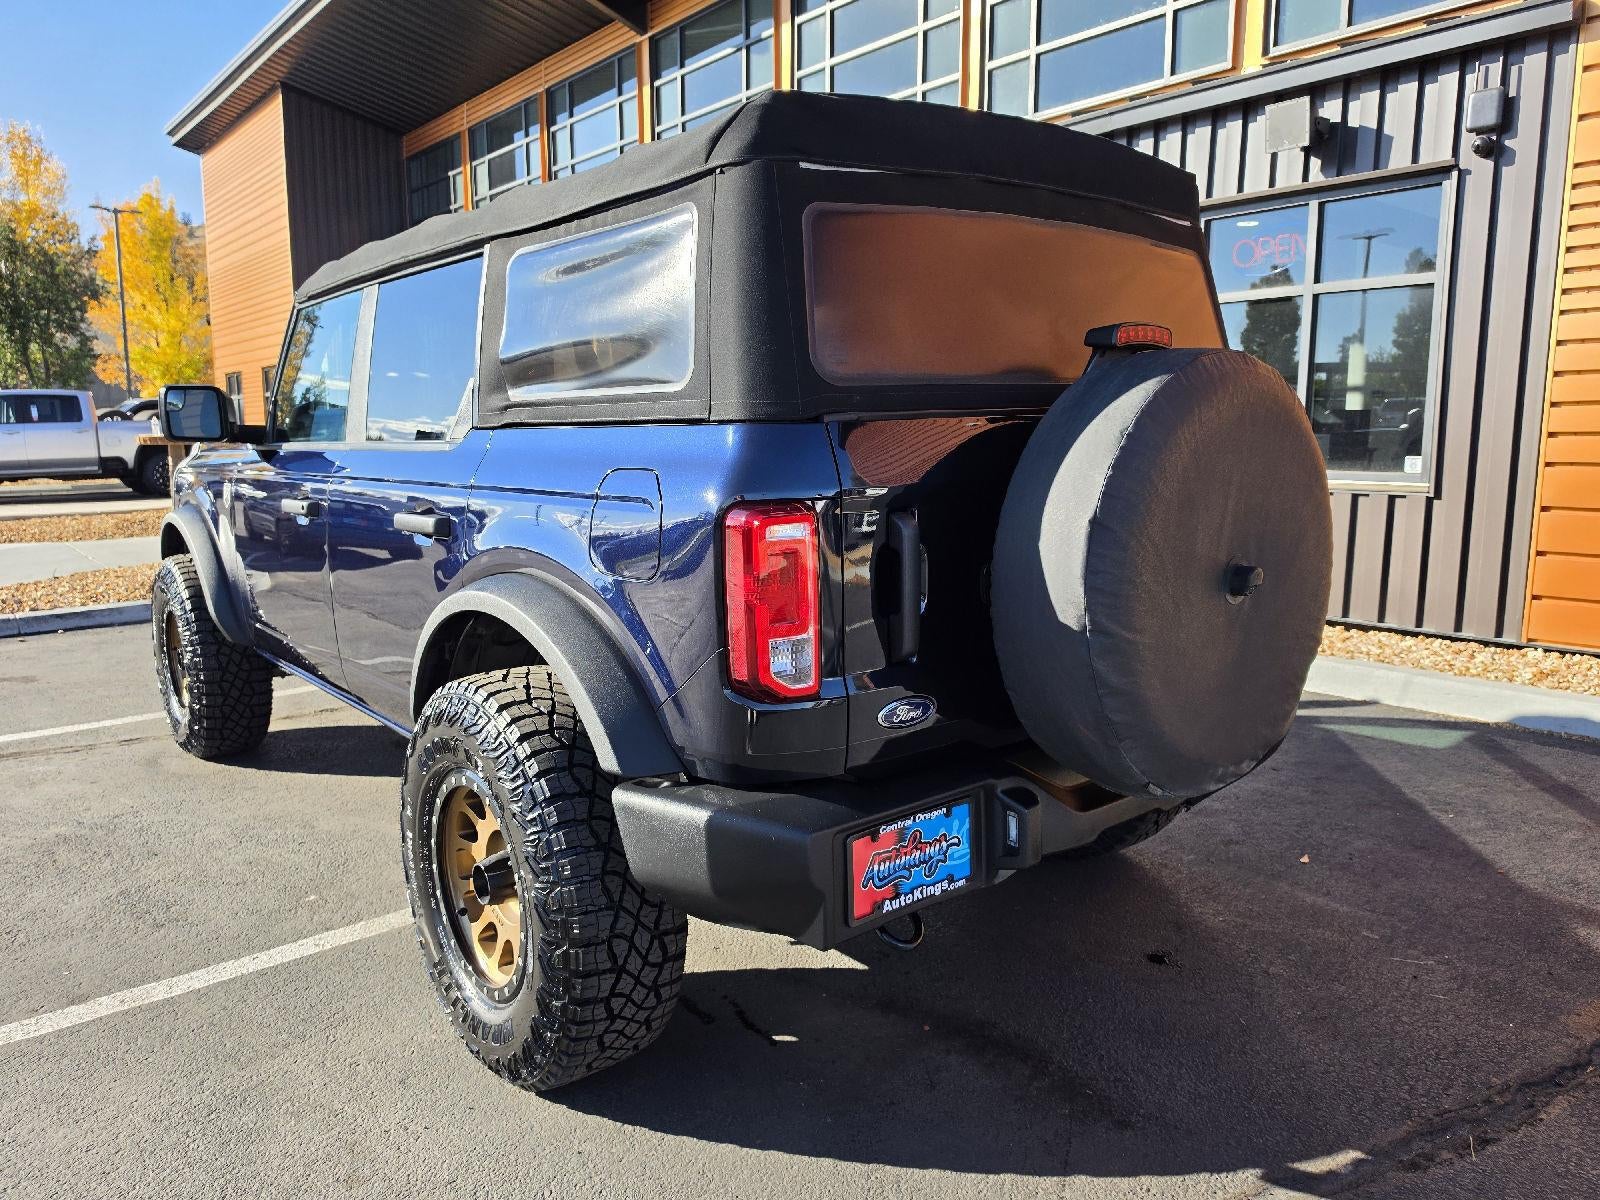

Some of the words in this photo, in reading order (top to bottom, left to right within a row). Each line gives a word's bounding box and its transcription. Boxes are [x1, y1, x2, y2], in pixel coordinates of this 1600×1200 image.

[1231, 233, 1307, 268] OPEN
[893, 705, 923, 723] Ford
[880, 815, 914, 835] Central
[915, 807, 947, 822] Oregon
[882, 879, 967, 913] AutoKings.com
